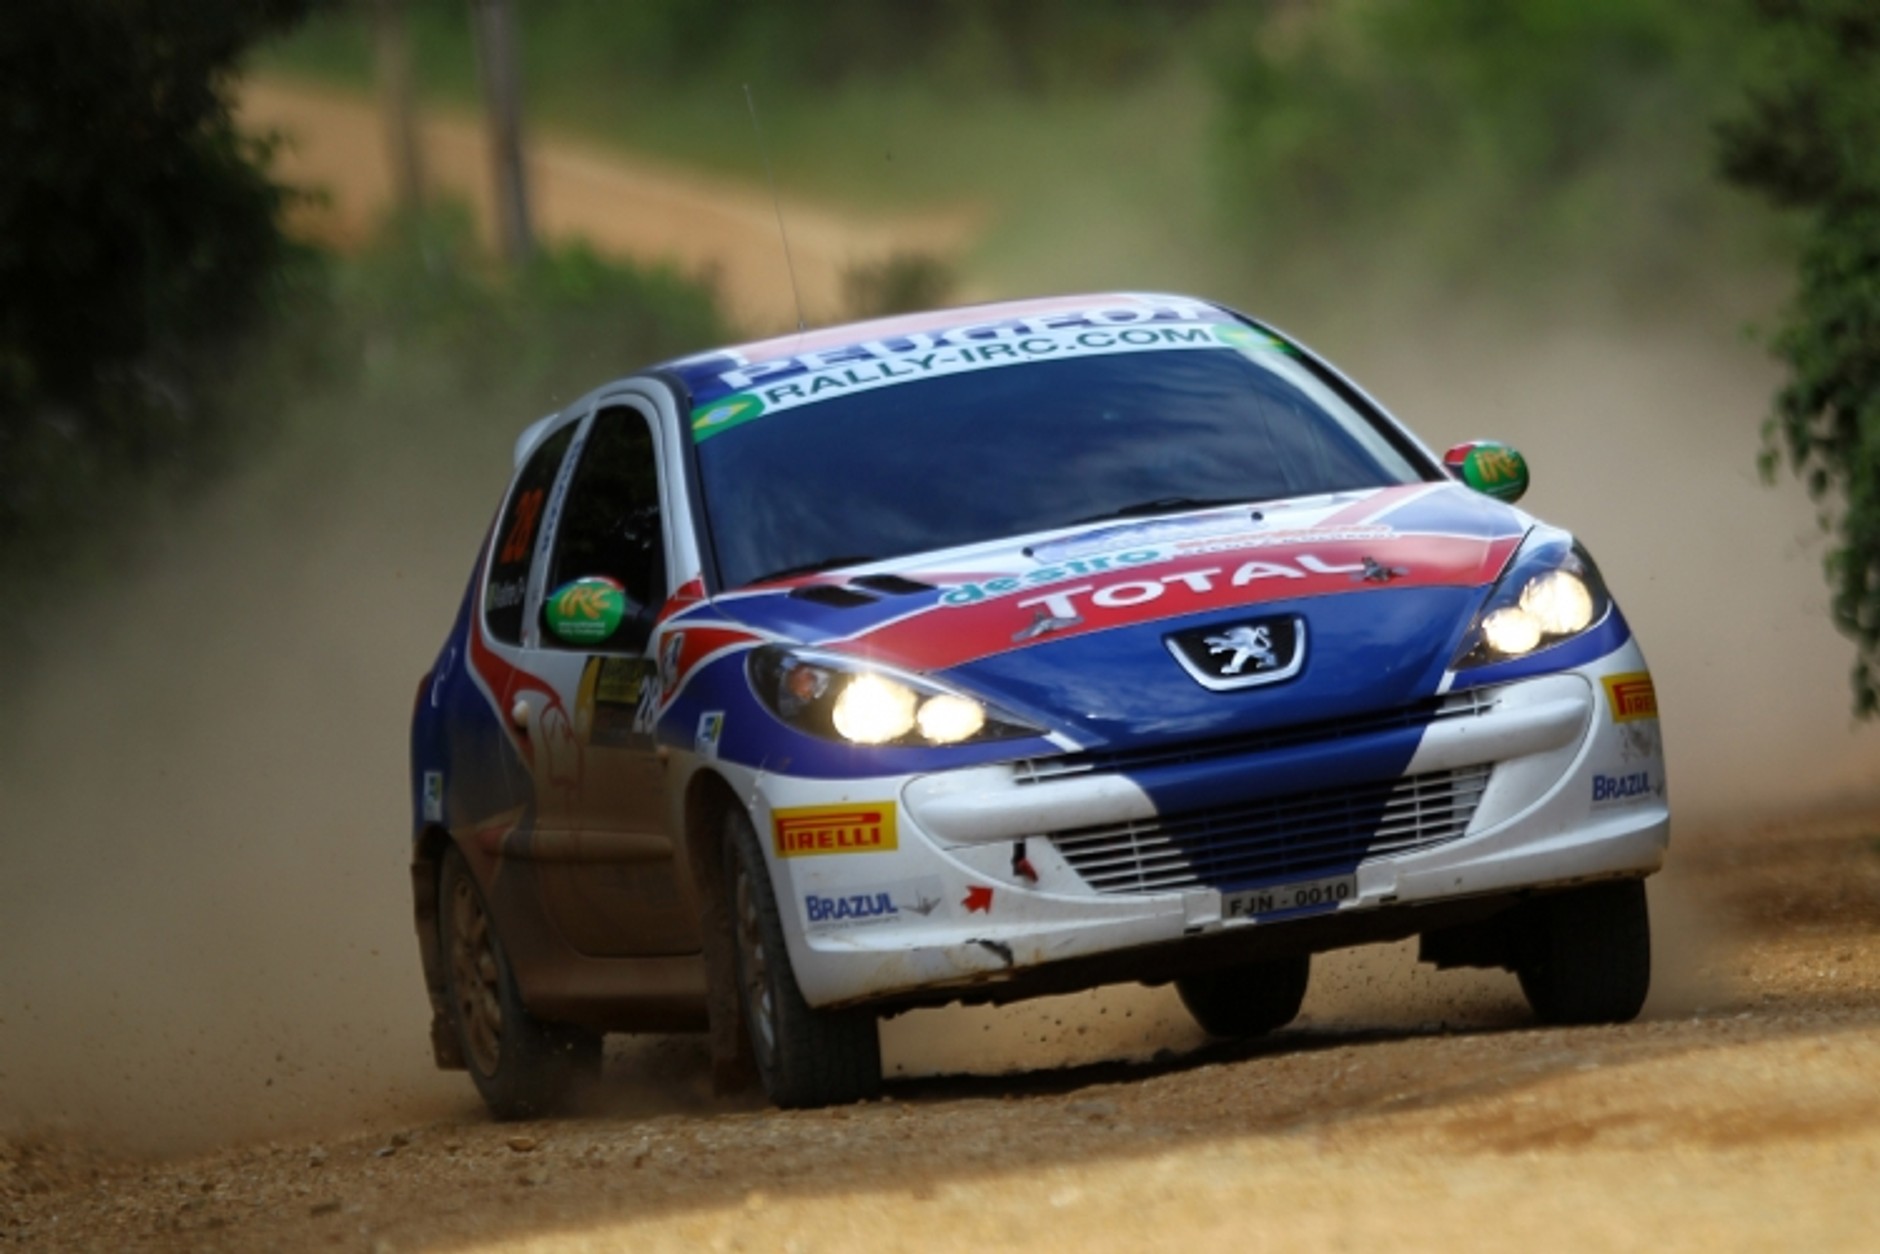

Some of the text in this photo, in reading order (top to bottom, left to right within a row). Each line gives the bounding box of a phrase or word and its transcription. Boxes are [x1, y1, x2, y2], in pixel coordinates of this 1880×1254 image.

[764, 328, 1212, 404] RALLY-IRC.COM
[944, 550, 1160, 604] destro
[1017, 554, 1364, 619] TOTAL
[1593, 771, 1650, 802] BRAZUL
[775, 812, 882, 852] PIRELLI
[805, 892, 899, 922] BRAZUL
[1230, 894, 1273, 916] FJN
[1295, 882, 1349, 906] 0010
